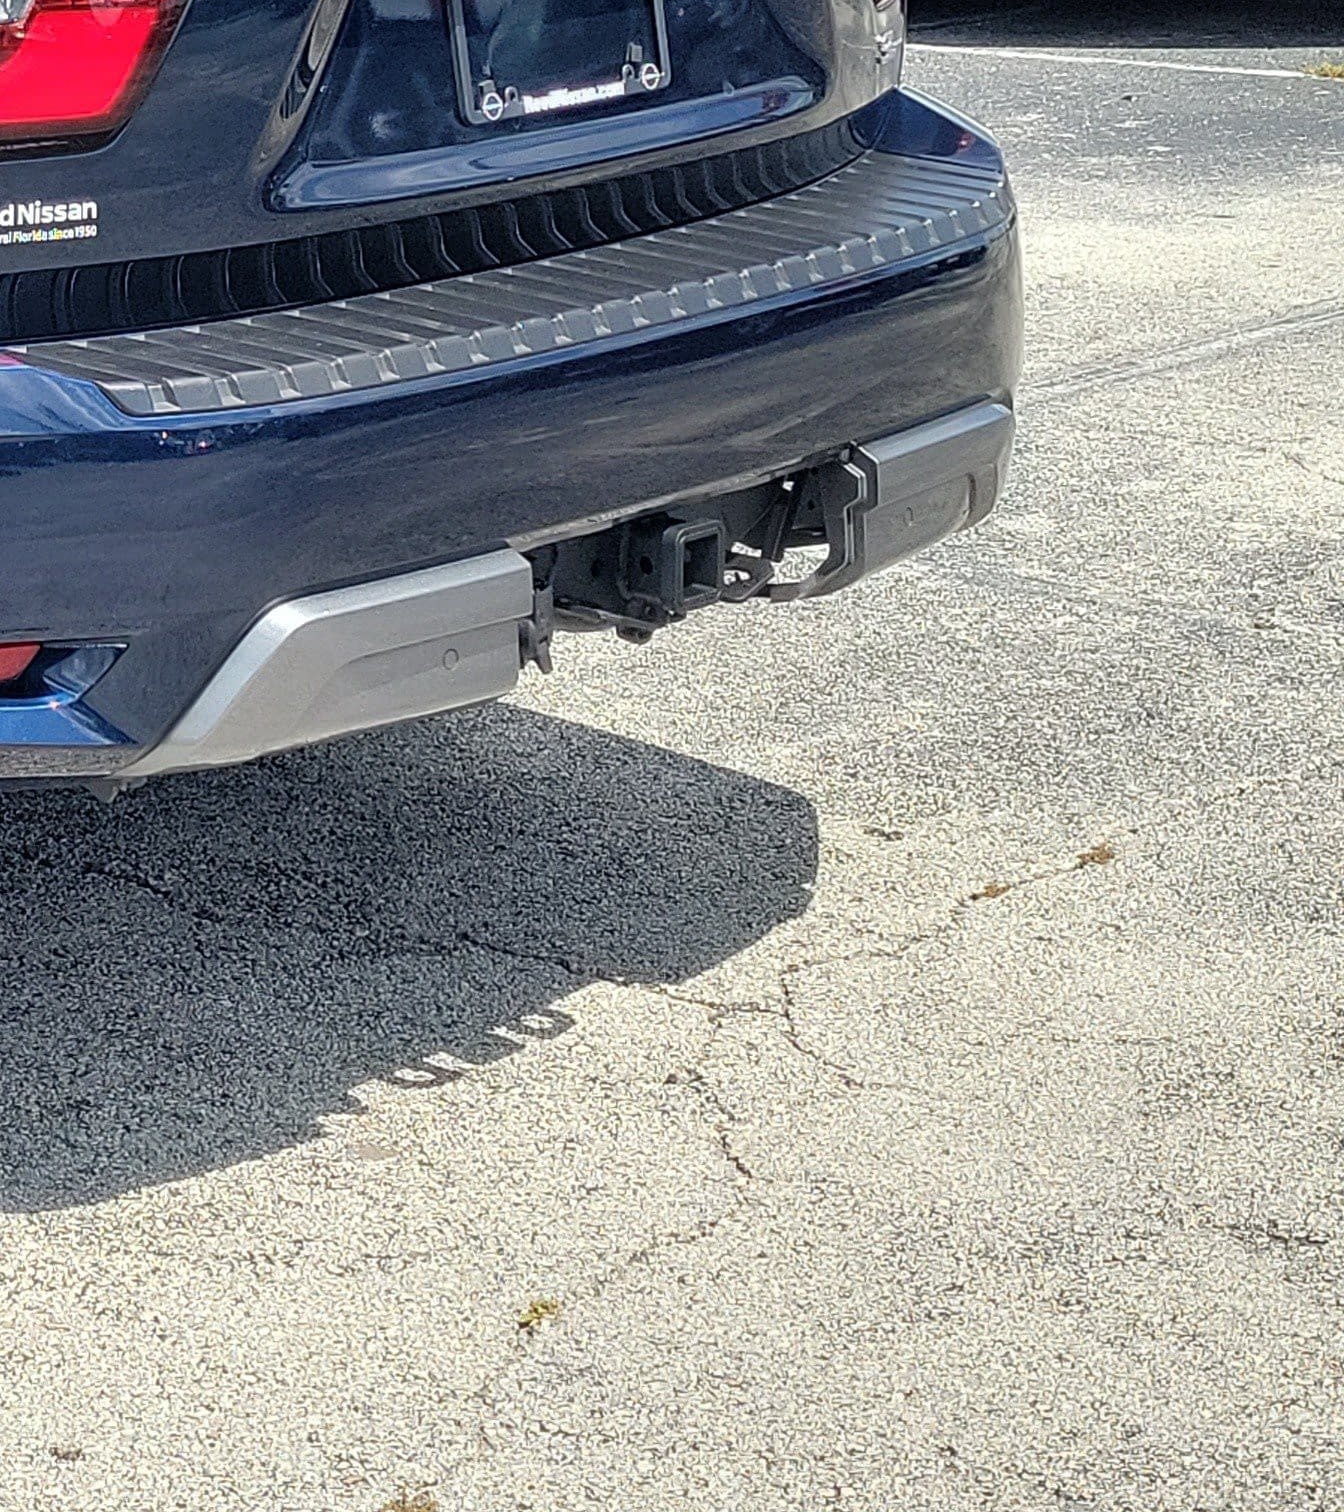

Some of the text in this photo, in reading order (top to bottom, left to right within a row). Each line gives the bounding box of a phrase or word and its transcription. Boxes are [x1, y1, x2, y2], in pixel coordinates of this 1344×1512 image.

[17, 199, 98, 222] Nissan
[12, 228, 48, 243] Florida
[48, 226, 74, 240] since
[75, 224, 98, 238] 1950
